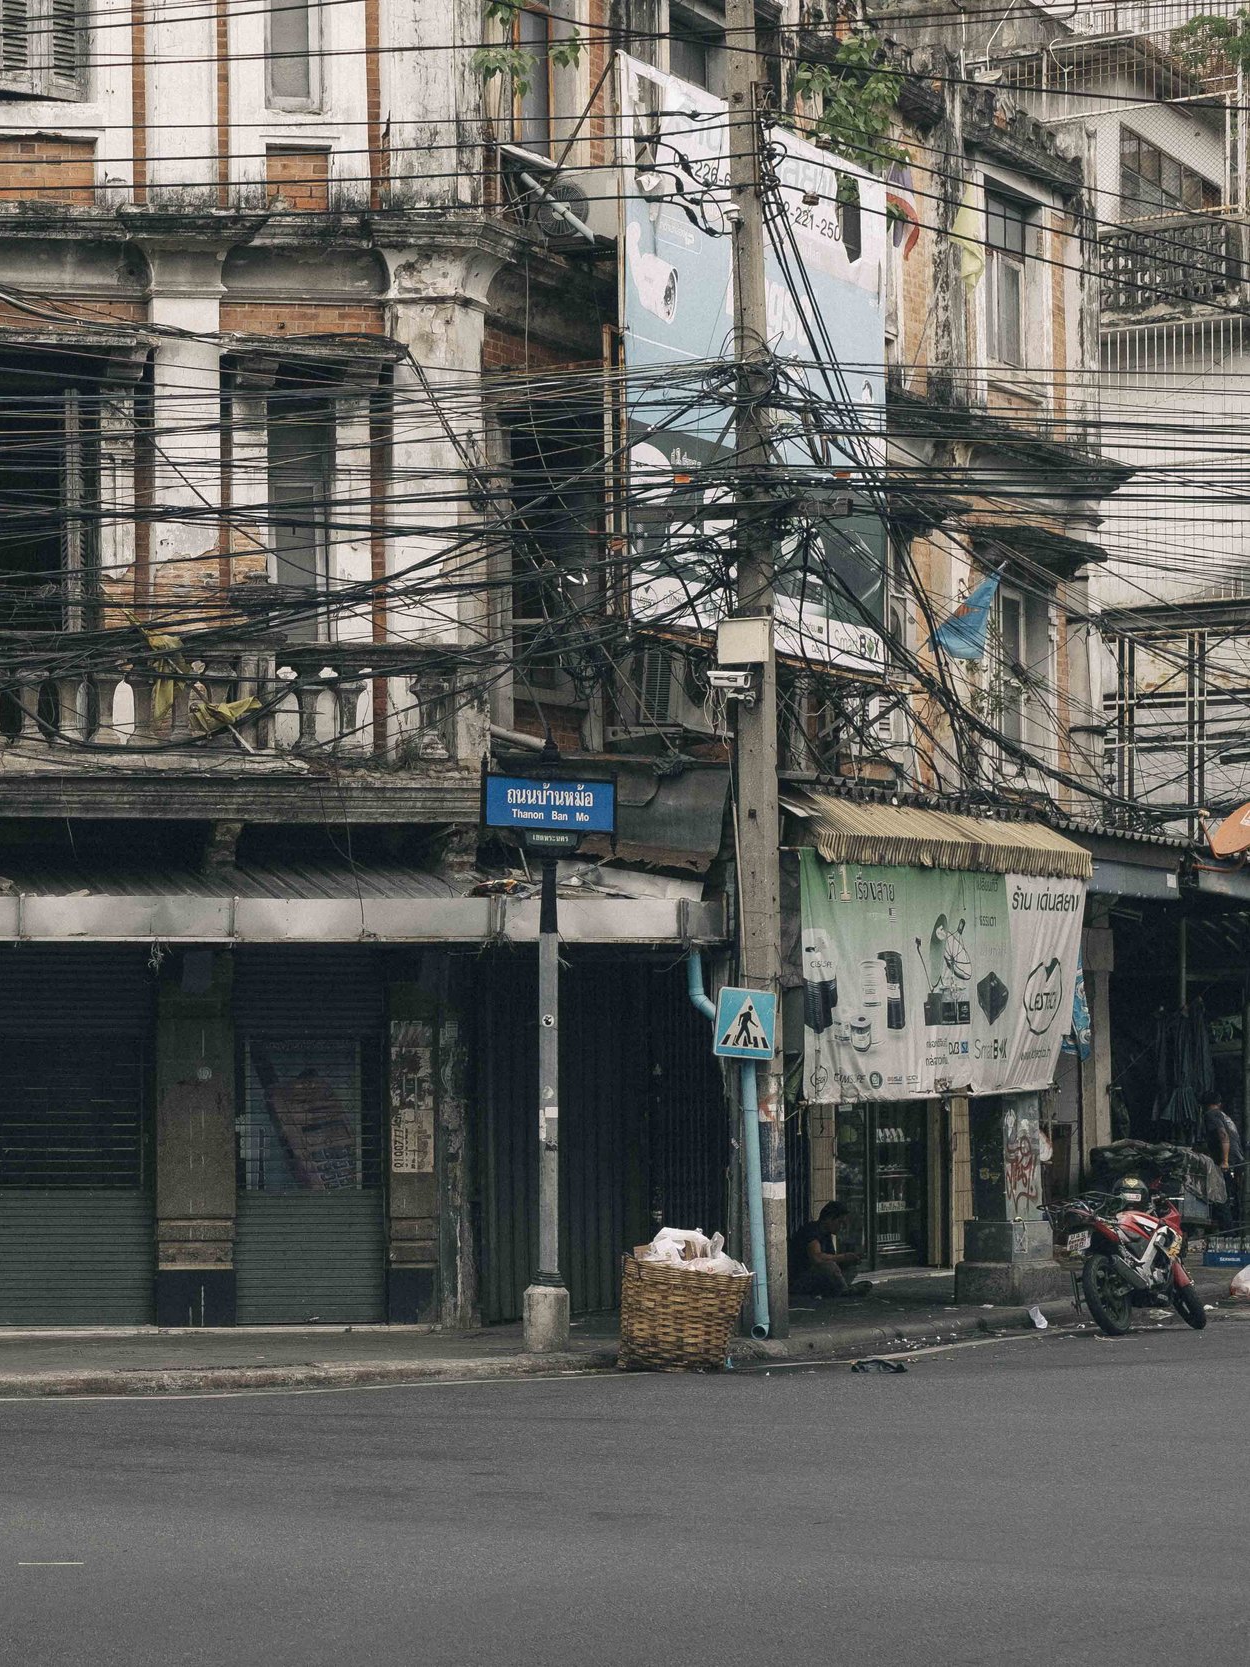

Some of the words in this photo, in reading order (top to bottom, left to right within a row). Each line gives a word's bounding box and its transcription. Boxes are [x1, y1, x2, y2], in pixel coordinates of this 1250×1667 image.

[507, 783, 594, 807] ถนนบ้านหม้อ
[512, 808, 544, 820] Thanon
[551, 811, 568, 821] Ban
[575, 812, 590, 822] Mo
[1012, 885, 1033, 911] ร้าน
